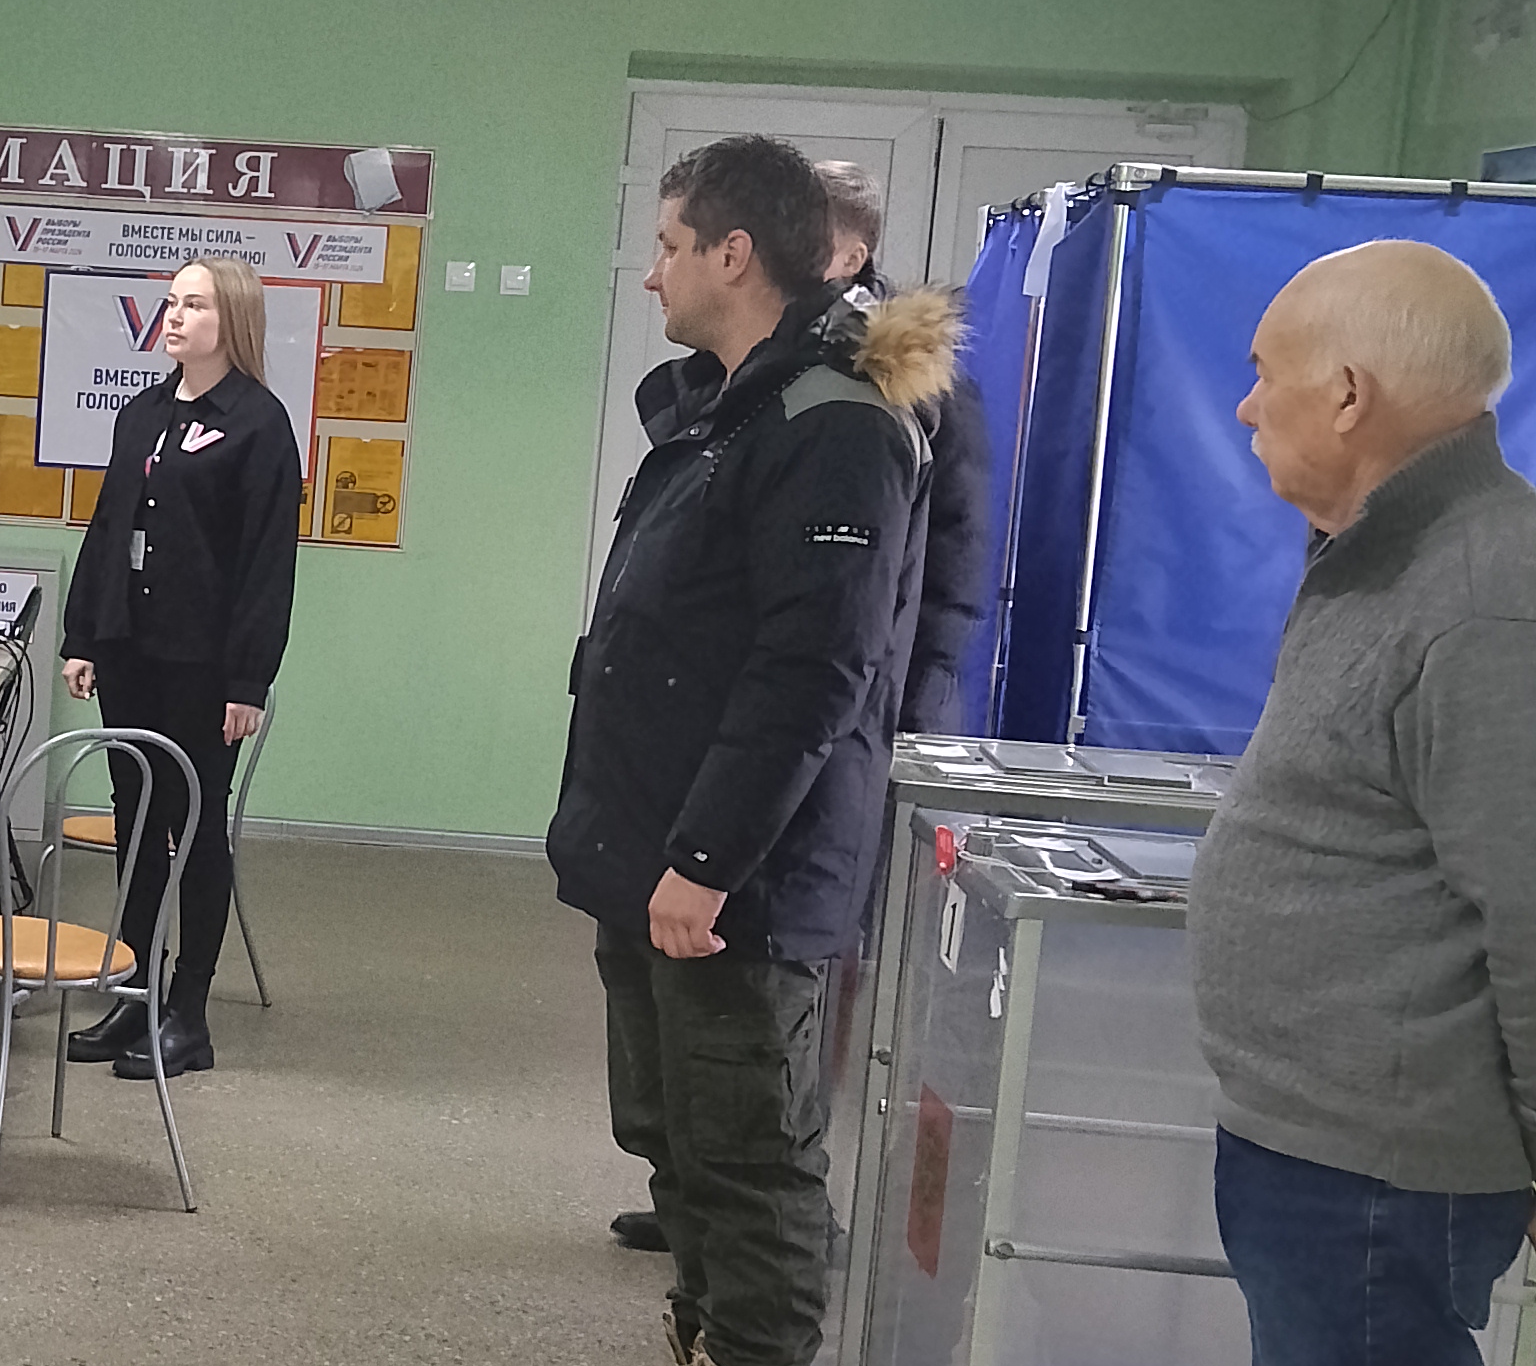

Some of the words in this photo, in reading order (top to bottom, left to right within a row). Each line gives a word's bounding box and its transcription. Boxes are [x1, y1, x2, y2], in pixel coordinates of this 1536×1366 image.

[122, 224, 175, 241] ВМЕСТЕ
[178, 227, 202, 242] МЫ
[206, 229, 242, 244] СИЛА
[108, 243, 179, 260] ГОЛОСУЕМ
[183, 247, 199, 260] ЗА
[93, 368, 160, 387] ВМЕСТЕ
[76, 392, 135, 410] ГОЛОС
